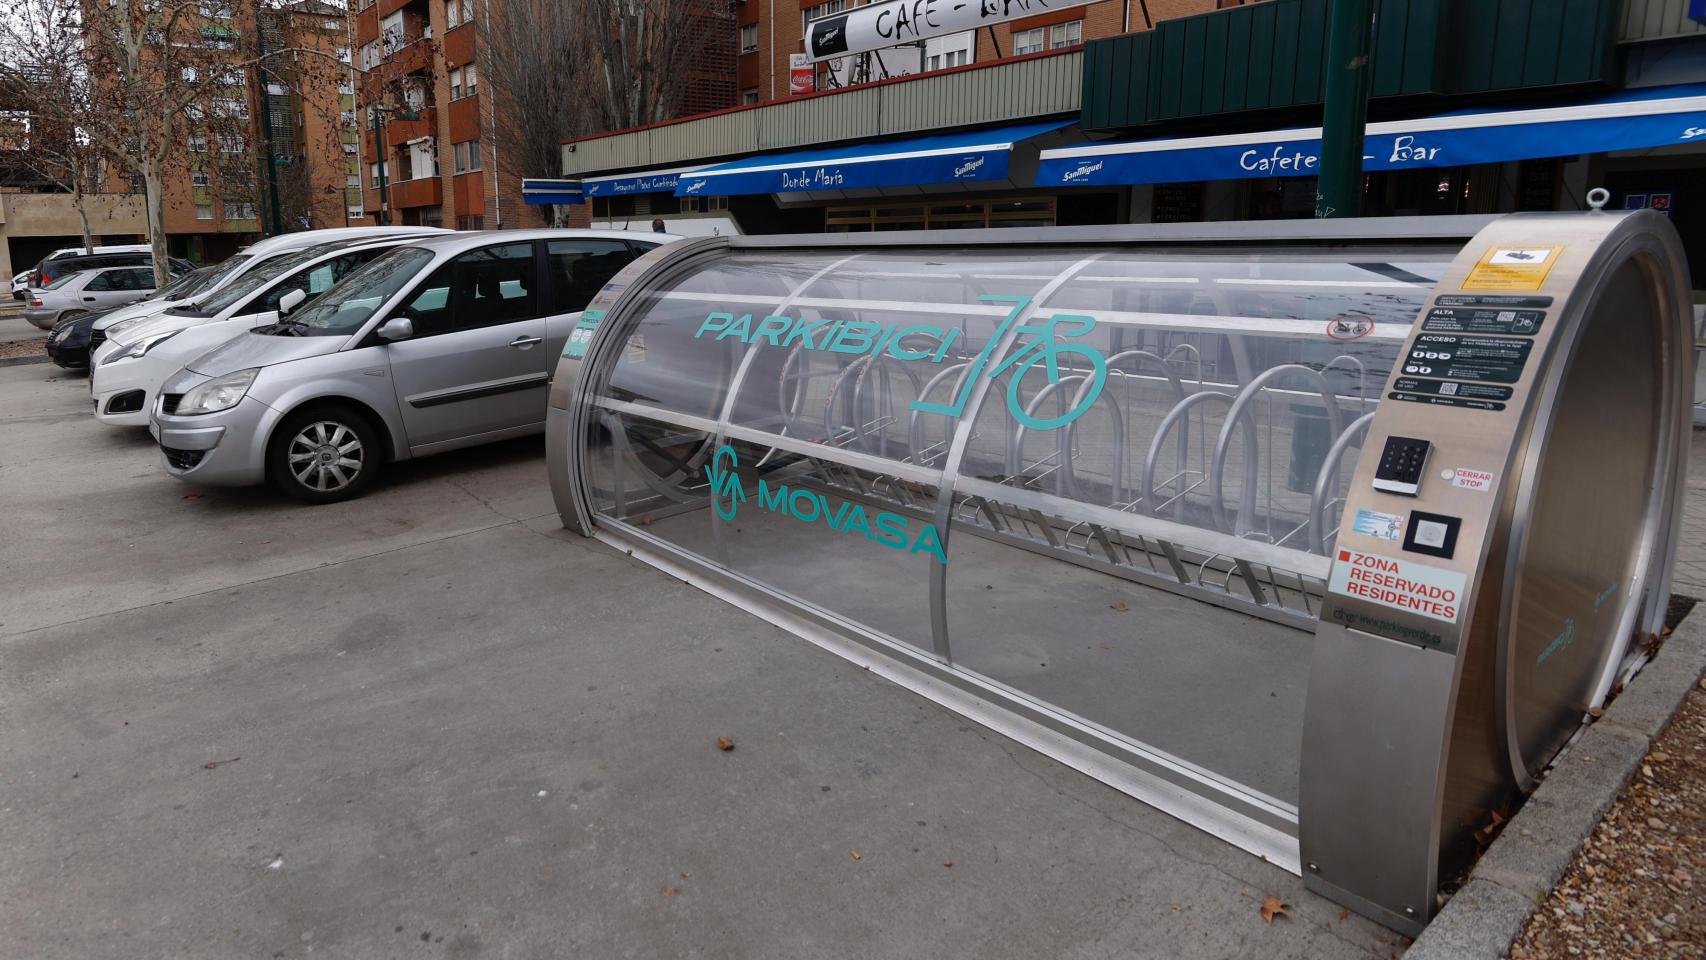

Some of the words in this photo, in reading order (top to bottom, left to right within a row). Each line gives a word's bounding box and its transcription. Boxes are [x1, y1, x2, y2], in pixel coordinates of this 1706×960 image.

[981, 0, 1049, 18] BA
[1240, 146, 1321, 175] Cafete
[1388, 135, 1441, 162] Bar
[652, 175, 680, 188] Combinado
[782, 170, 811, 188] Donde
[815, 167, 843, 185] María
[694, 312, 961, 363] PARKIBICI
[1457, 469, 1491, 481] CERRAR
[1459, 478, 1482, 488] STOP
[758, 480, 947, 563] MOVASA
[1352, 553, 1399, 574] ZONA
[1350, 568, 1456, 602] RESERVADO
[1347, 582, 1456, 619] RESIDENTES
